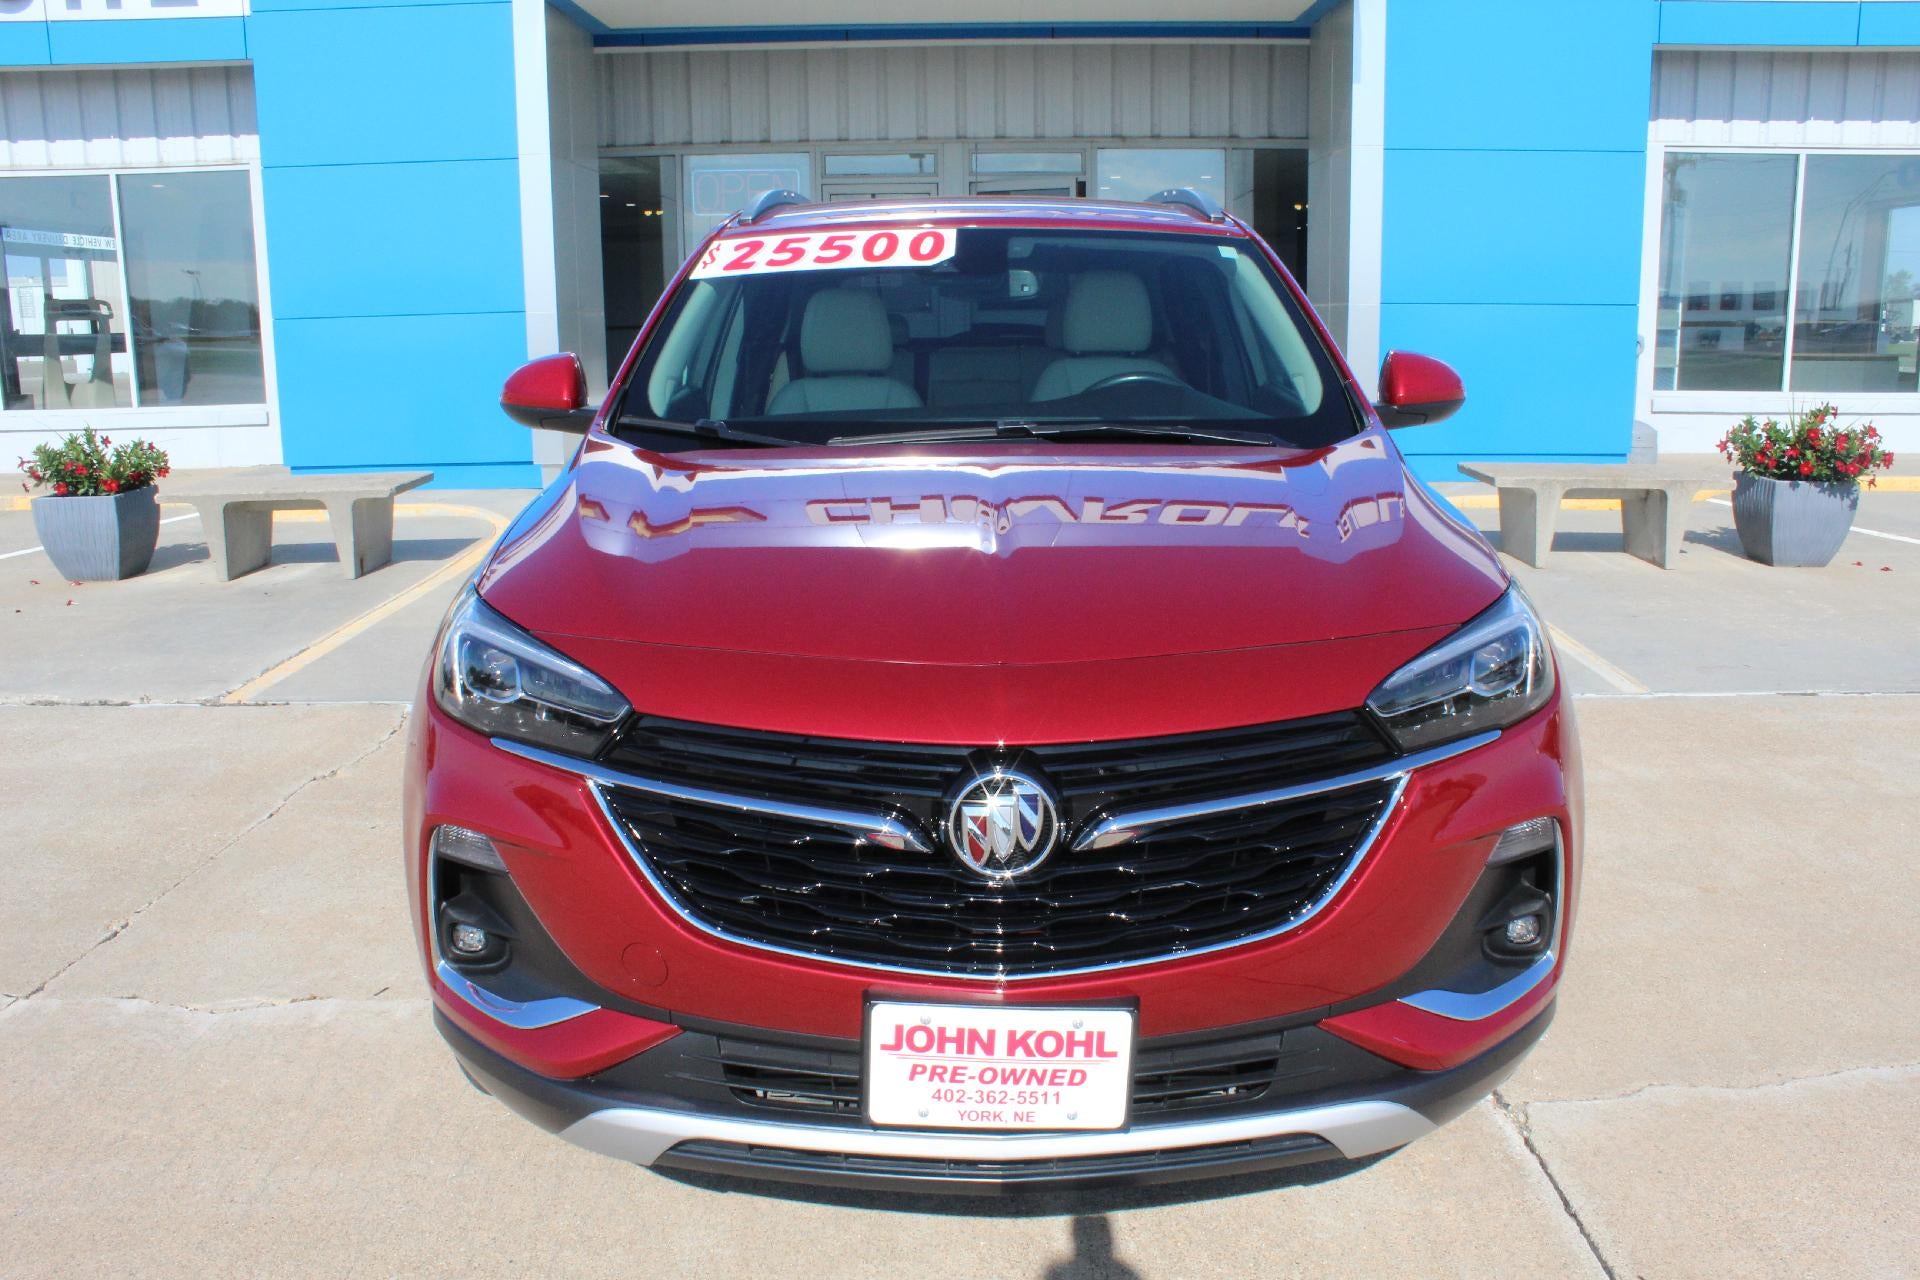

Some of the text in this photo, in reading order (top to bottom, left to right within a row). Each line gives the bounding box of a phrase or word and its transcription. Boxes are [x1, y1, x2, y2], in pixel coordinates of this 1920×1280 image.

[880, 1024, 1118, 1058] JOHN KOHL
[908, 1063, 1088, 1087] PRE-OWNED
[931, 1088, 1061, 1105] 402-362-5511
[957, 1109, 1036, 1123] YORK, NE
